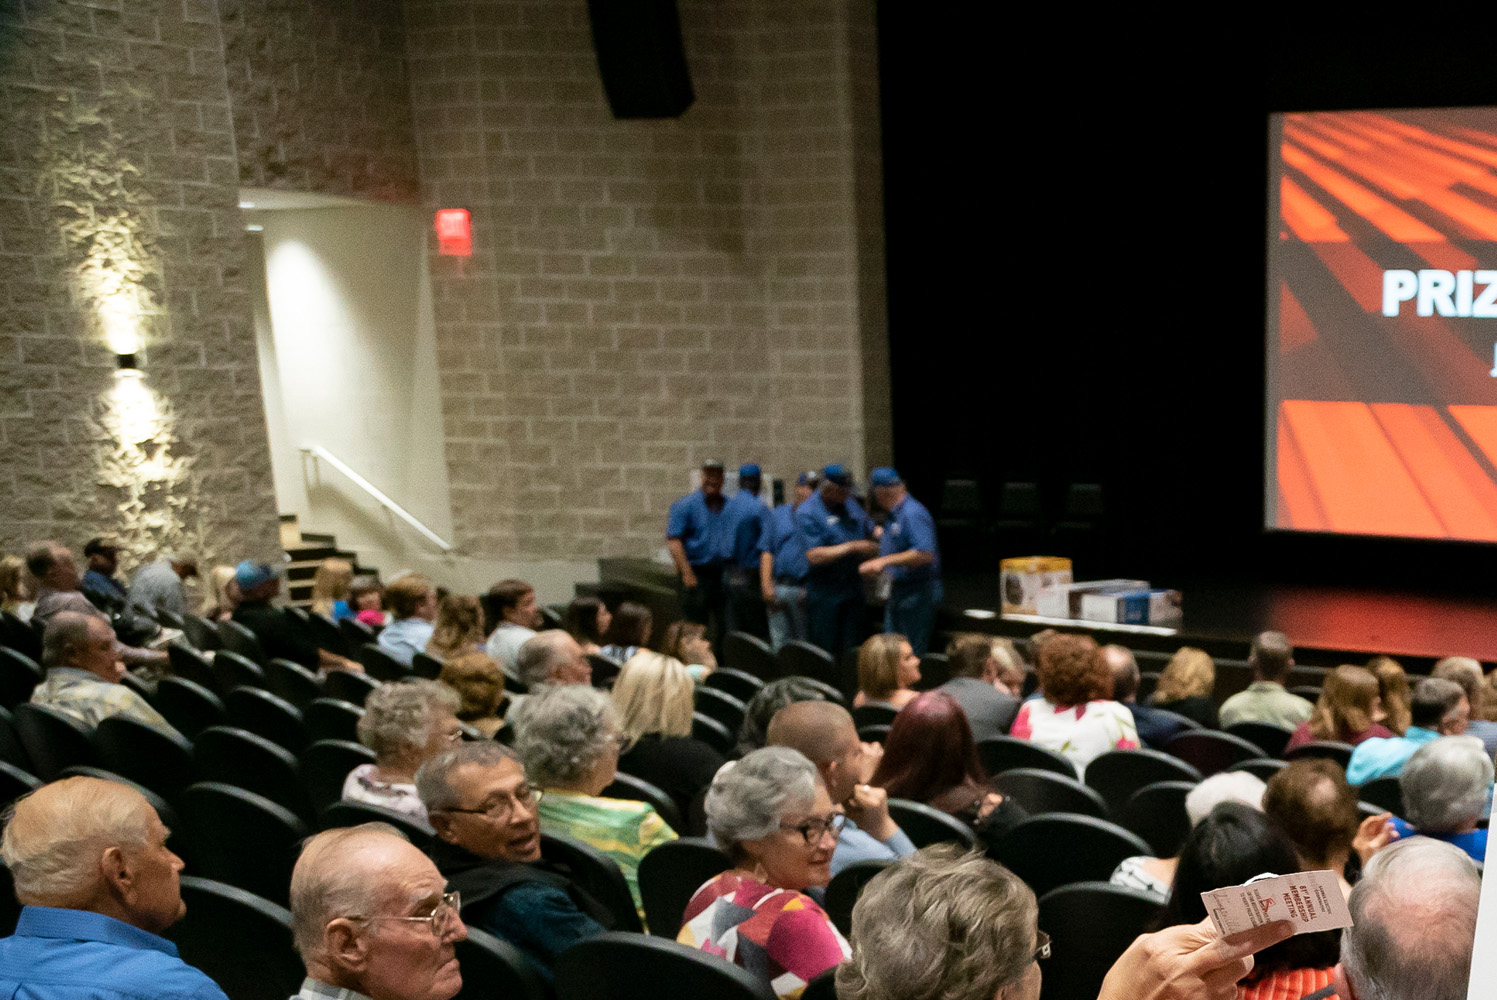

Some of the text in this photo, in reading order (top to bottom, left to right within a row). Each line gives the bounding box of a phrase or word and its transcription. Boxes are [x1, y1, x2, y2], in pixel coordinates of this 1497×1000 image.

[1282, 893, 1298, 918] MEETING
[1290, 885, 1309, 922] MEMBERSHIP
[1303, 896, 1317, 920] ANNUAL
